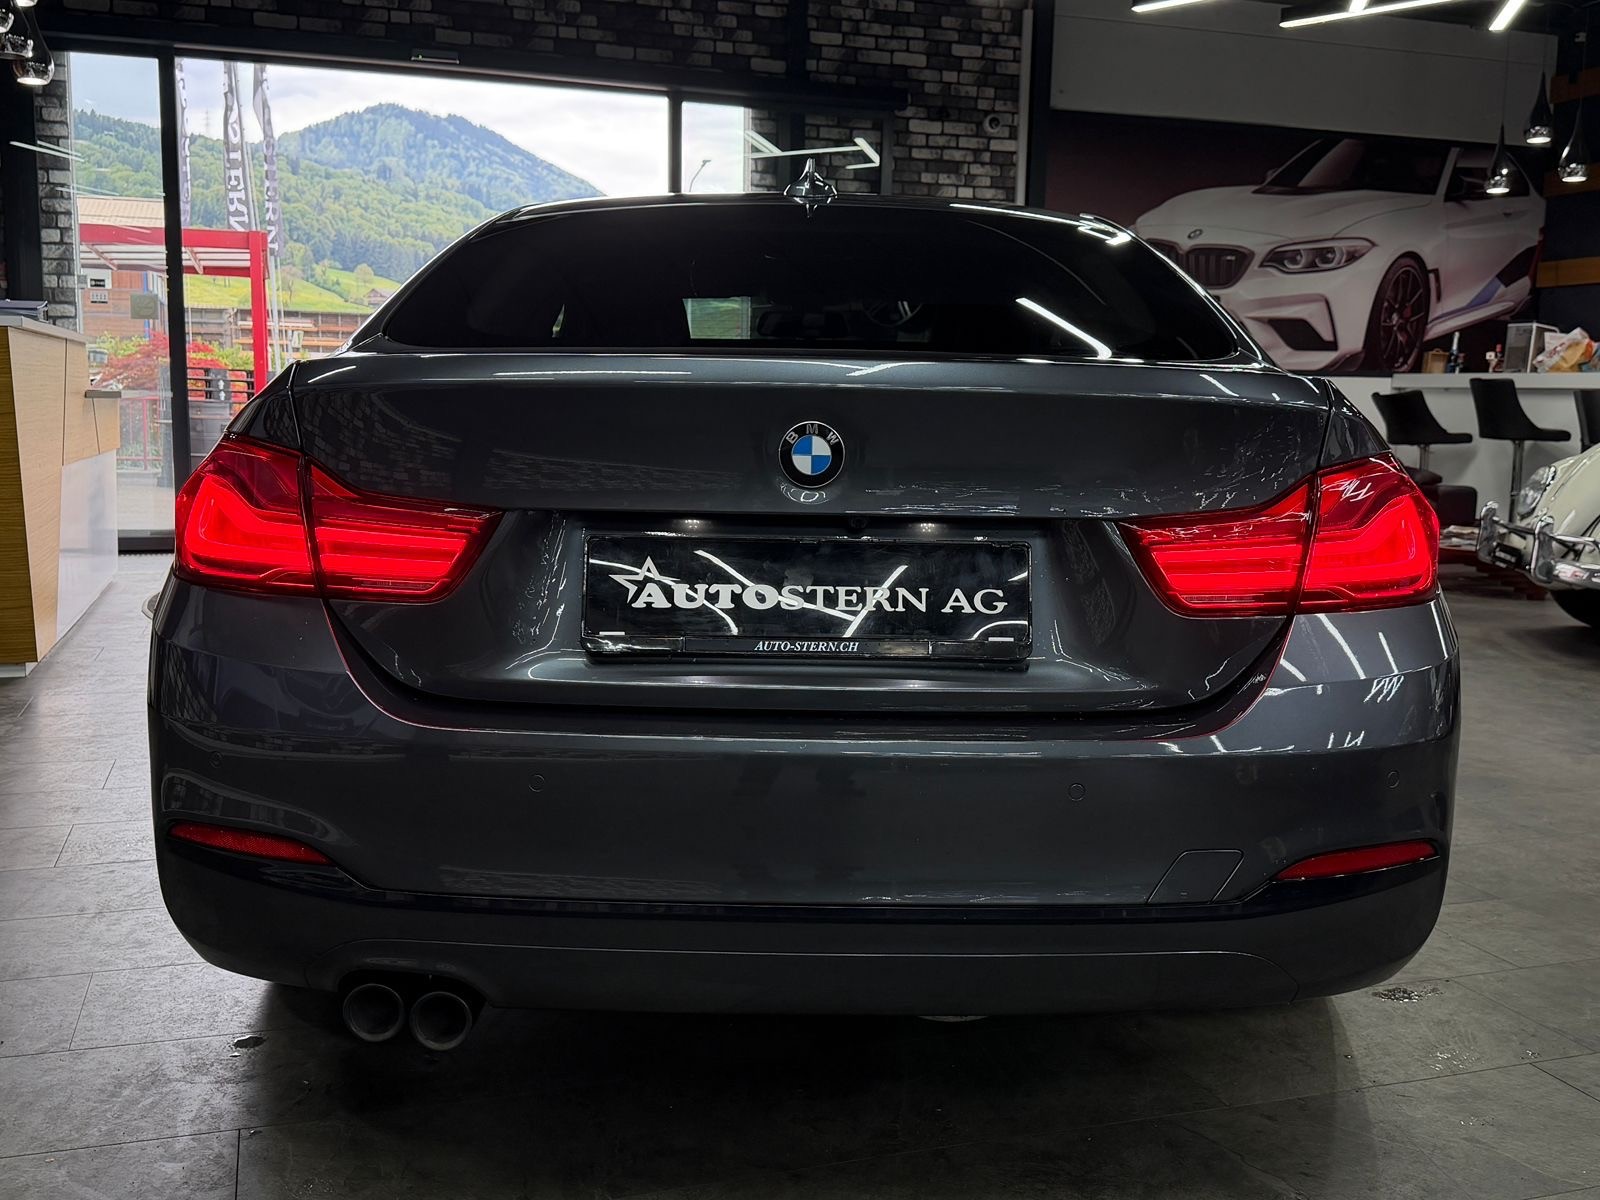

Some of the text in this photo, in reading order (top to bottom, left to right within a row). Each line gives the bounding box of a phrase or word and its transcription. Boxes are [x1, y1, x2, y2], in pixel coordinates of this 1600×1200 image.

[785, 423, 839, 446] BMW
[631, 582, 1008, 615] AUTOSTERN AG
[754, 640, 859, 652] AUTO-STERN.CH
